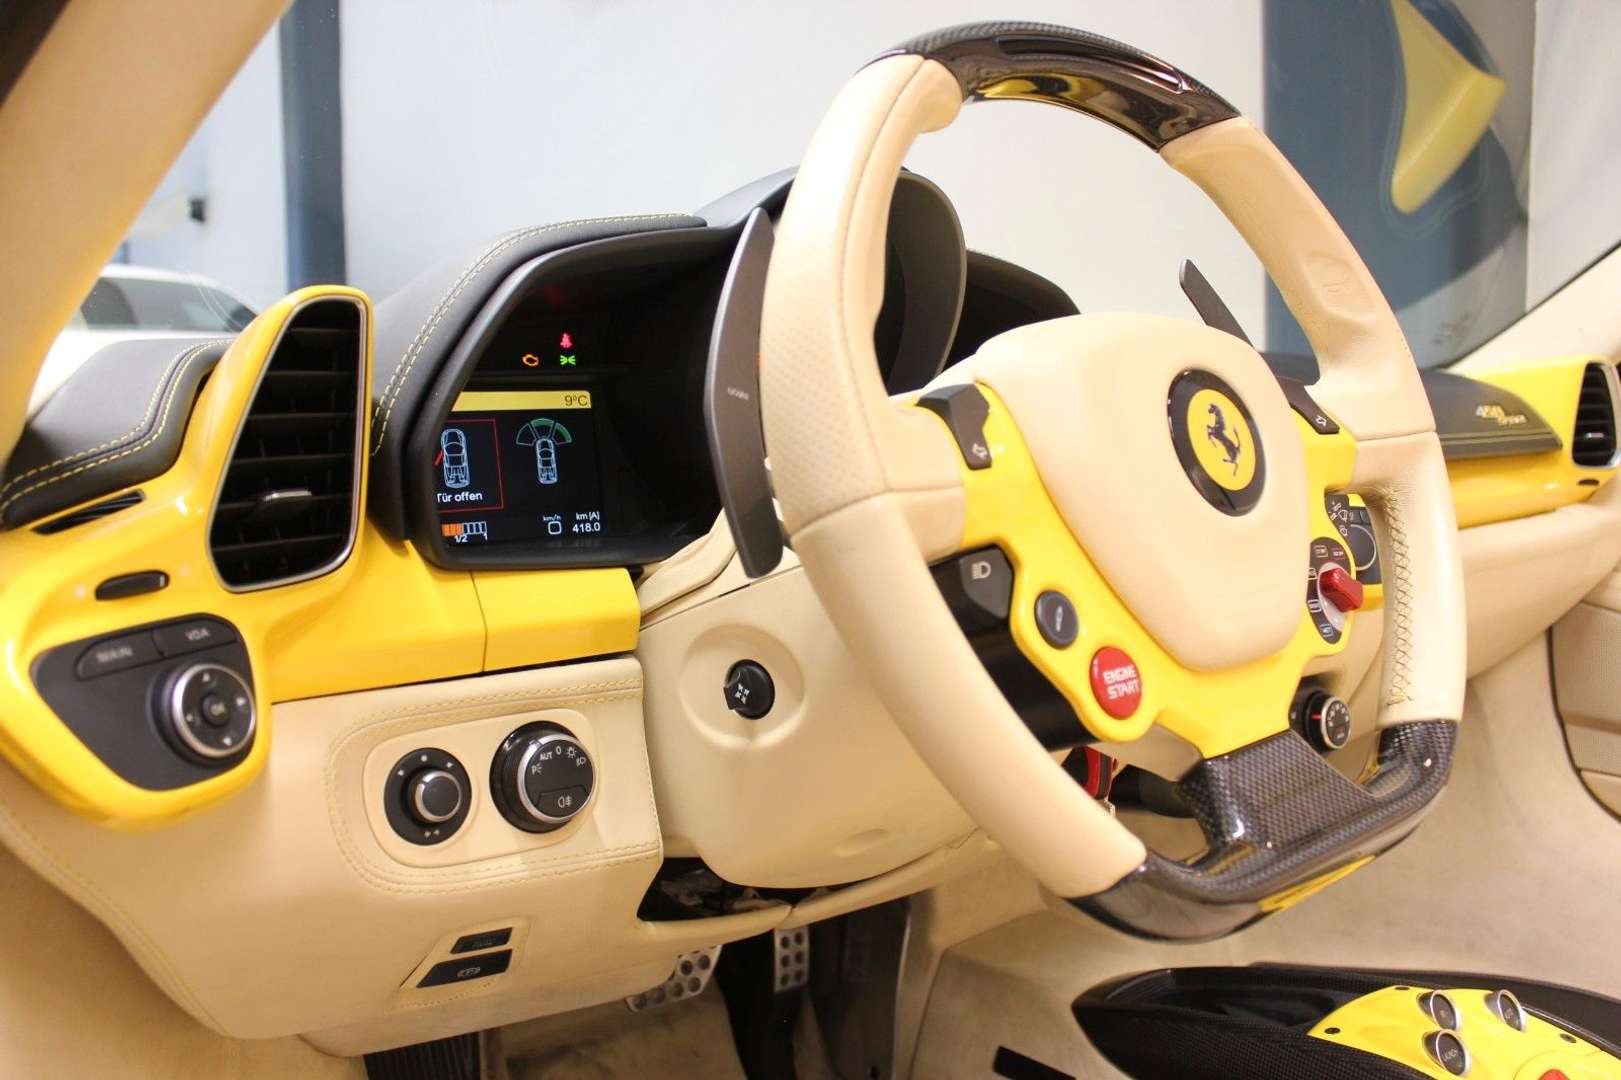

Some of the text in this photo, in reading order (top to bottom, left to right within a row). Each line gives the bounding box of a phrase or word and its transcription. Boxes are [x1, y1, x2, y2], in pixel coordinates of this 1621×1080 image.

[436, 491, 483, 503] Tür offen
[575, 512, 588, 521] km
[572, 522, 601, 533] 418.0
[1103, 664, 1137, 684] ENGINE
[1106, 681, 1140, 700] START
